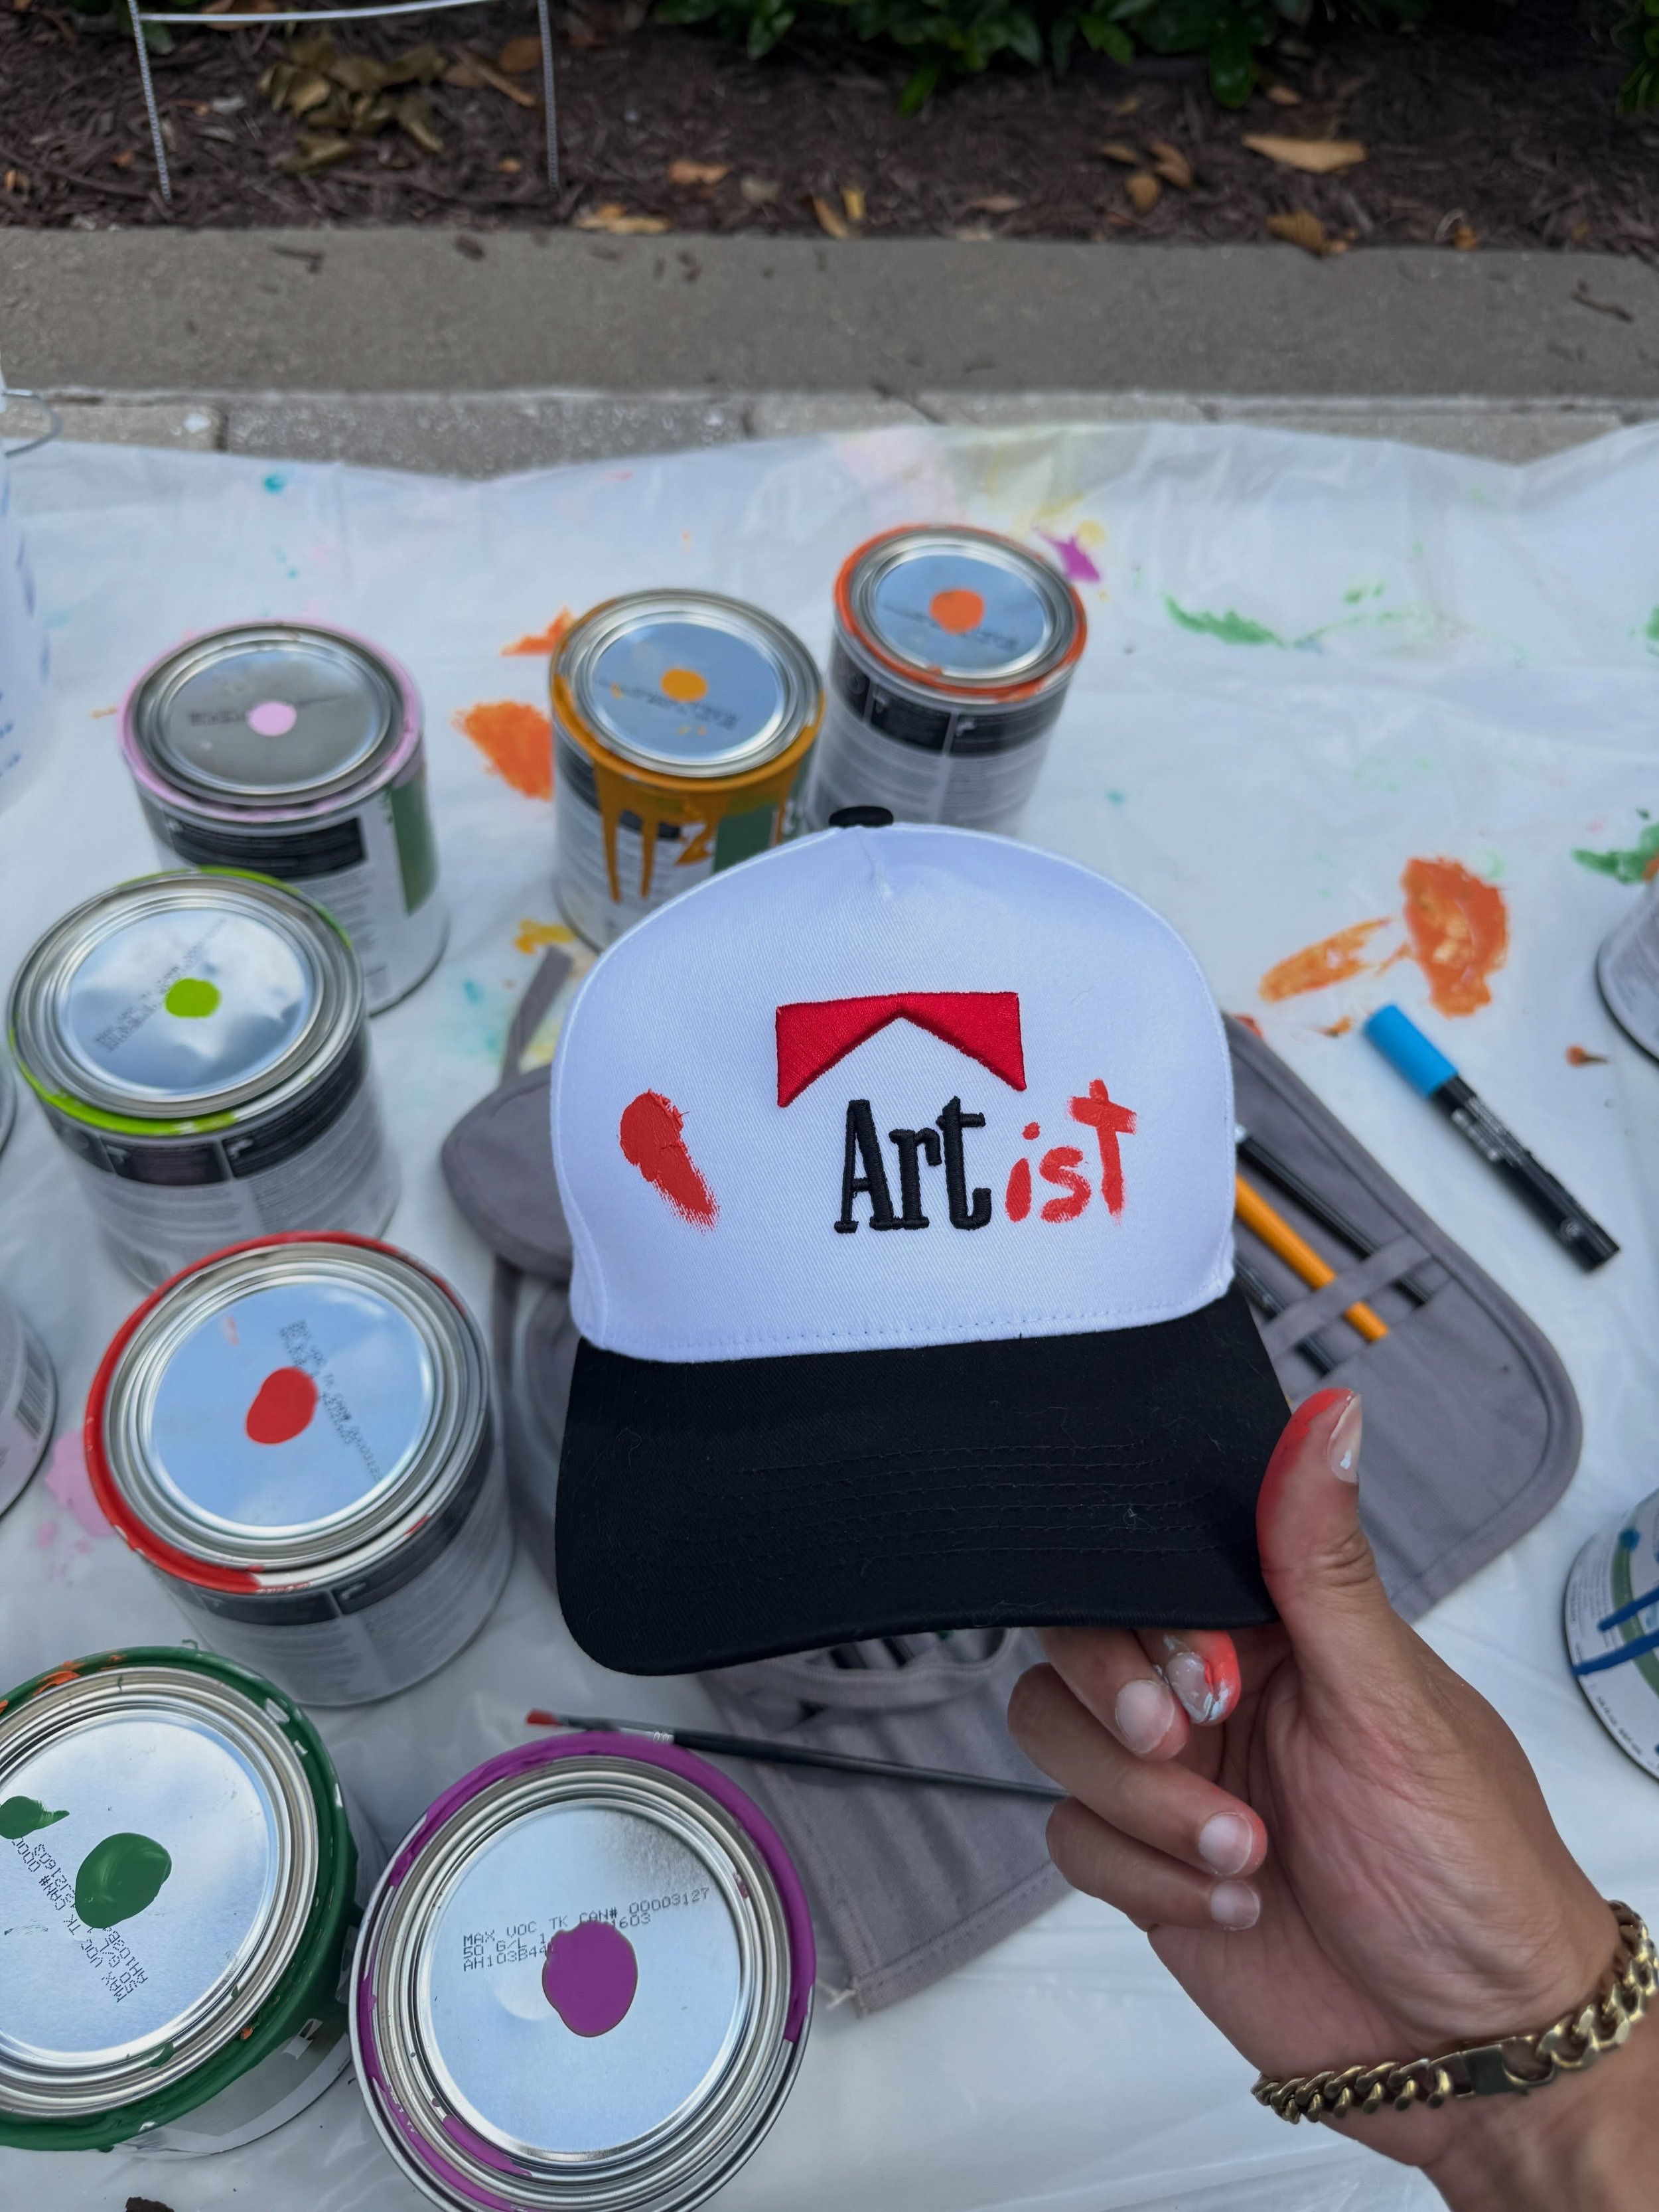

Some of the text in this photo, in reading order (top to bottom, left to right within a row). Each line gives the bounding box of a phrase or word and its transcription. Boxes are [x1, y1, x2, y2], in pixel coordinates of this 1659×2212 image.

[38, 1875, 66, 1911] CAN#
[63, 1914, 81, 1935] TK
[463, 1887, 709, 1947] MAX VOC TK CAN# 00003127
[81, 1939, 103, 1968] VOC
[100, 1938, 120, 1968] G/L
[463, 1944, 484, 1959] 50
[496, 1937, 527, 1953] G/L
[102, 1970, 127, 2003] MAX
[119, 1972, 137, 1994] 50
